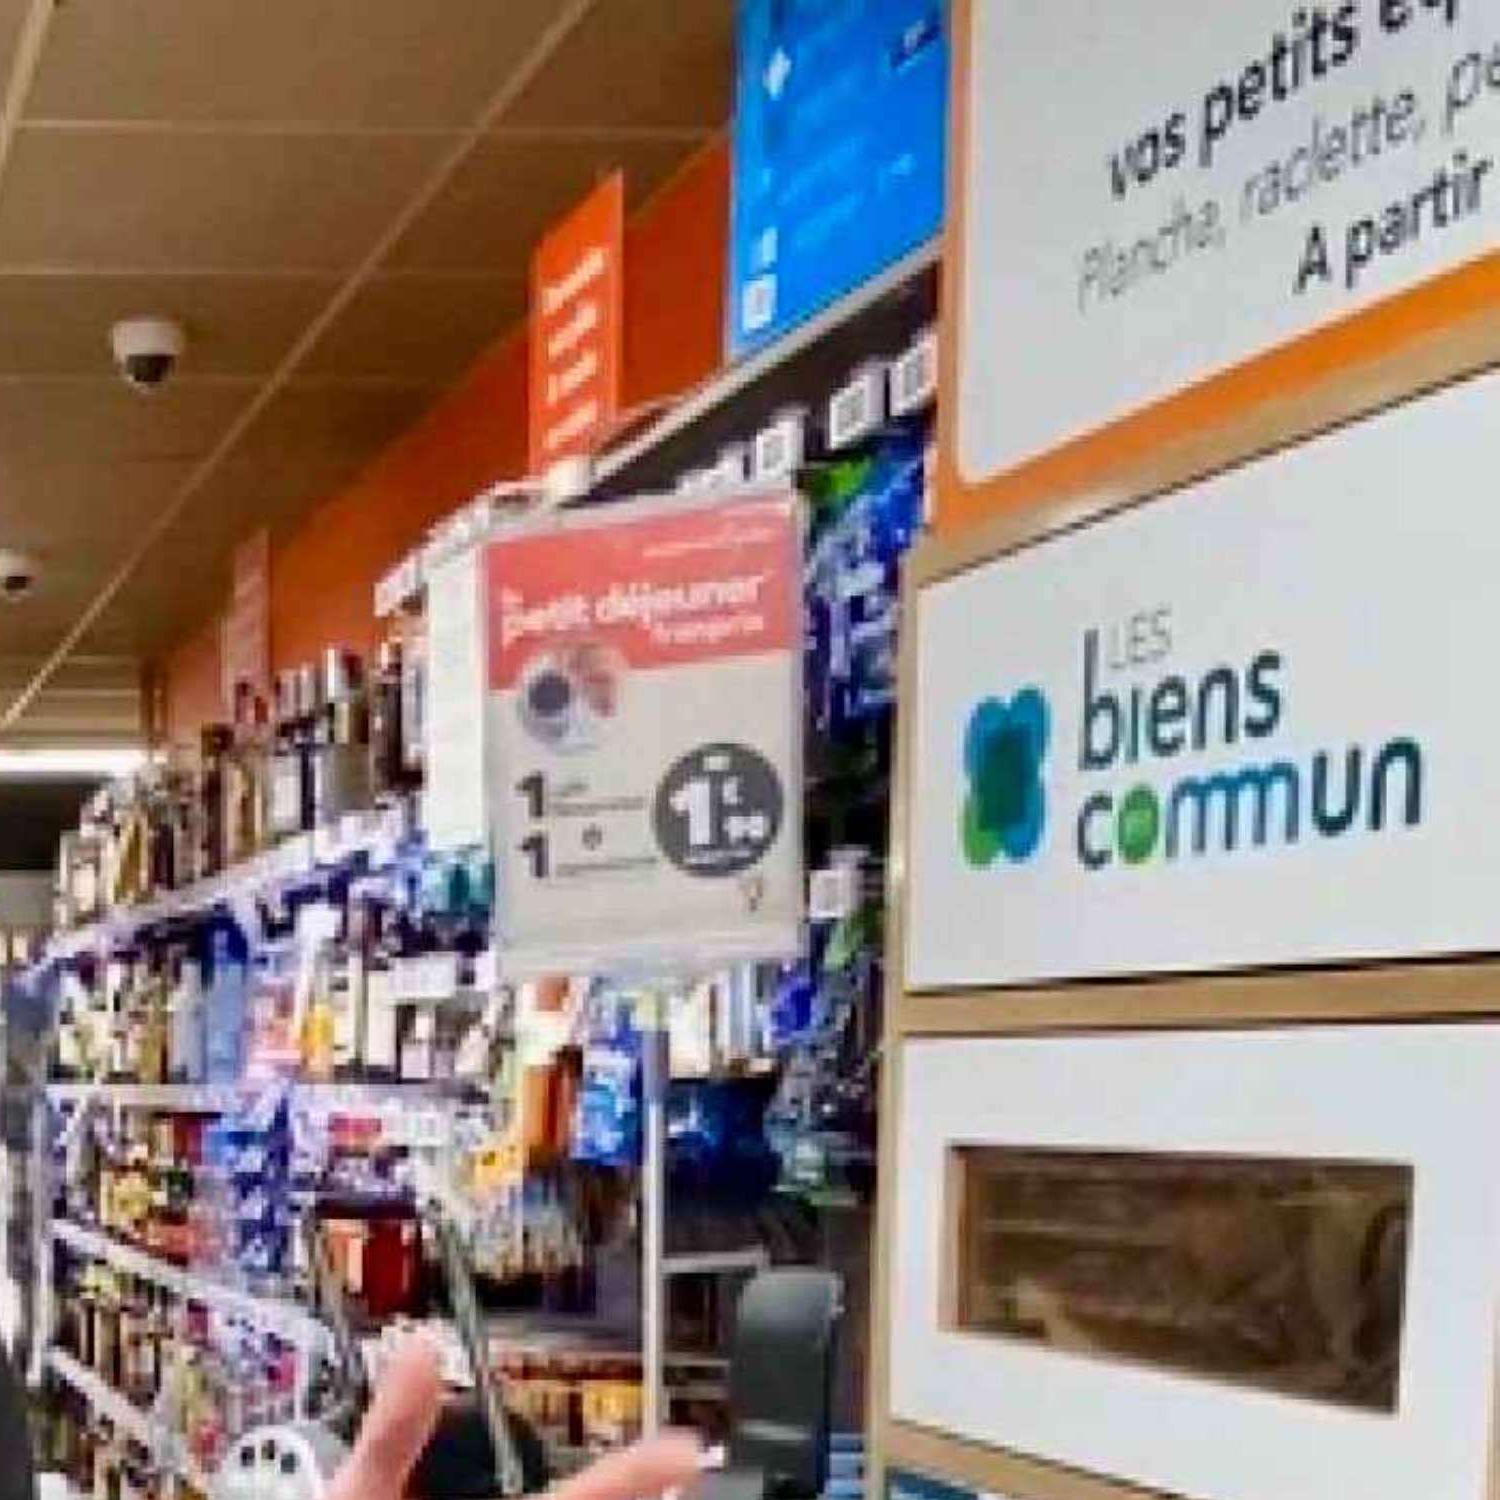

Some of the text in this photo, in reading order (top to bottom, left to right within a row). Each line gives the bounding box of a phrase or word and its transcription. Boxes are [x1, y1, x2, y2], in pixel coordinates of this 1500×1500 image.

[1109, 0, 1359, 198] vos petits
[1292, 148, 1494, 295] A partir
[1078, 628, 1283, 772] biens
[1107, 605, 1173, 672] LES
[1076, 736, 1424, 871] commun
